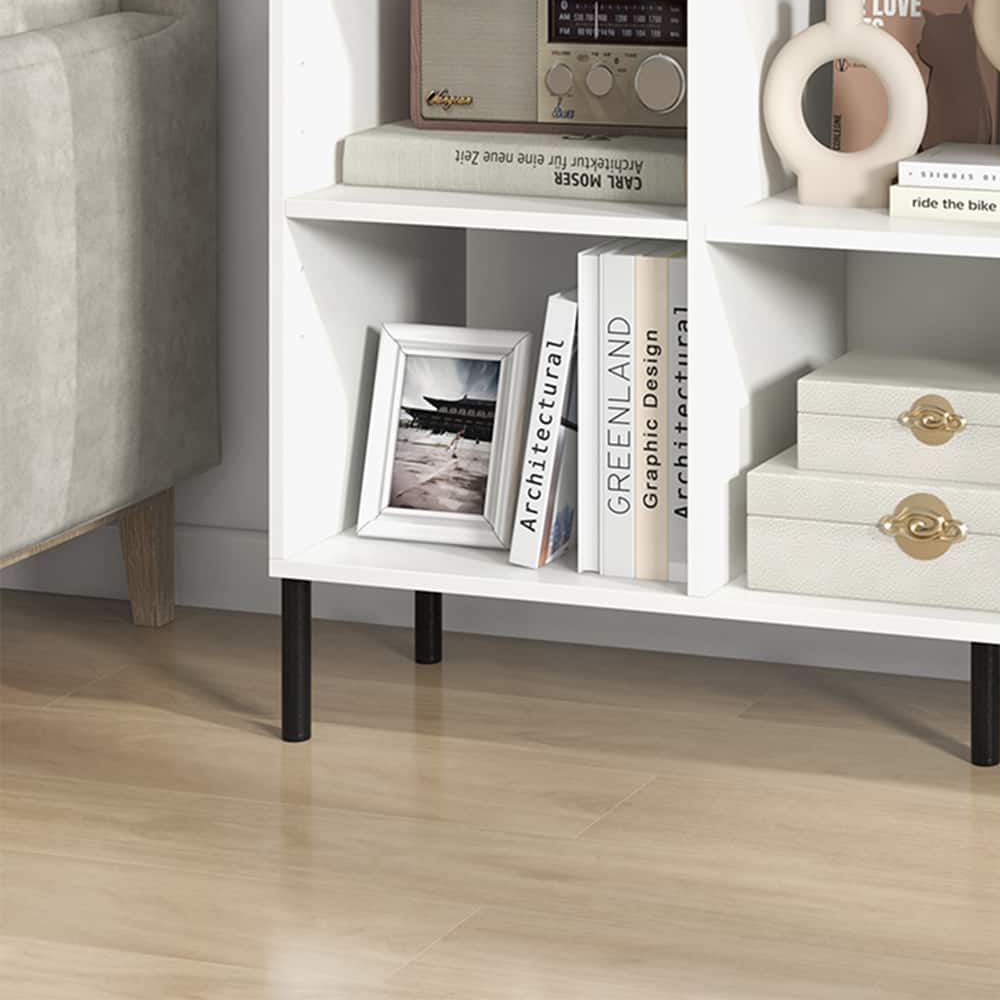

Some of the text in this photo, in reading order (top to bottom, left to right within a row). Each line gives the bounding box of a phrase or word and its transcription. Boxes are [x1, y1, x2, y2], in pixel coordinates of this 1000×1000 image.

[455, 149, 644, 174] Architektur für eine neue Zeit
[553, 171, 643, 190] CARL MOSER
[911, 196, 998, 212] ride the bike
[518, 337, 566, 533] Architectural
[606, 315, 632, 516] GREENLAND
[642, 328, 663, 510] Graphic Design
[672, 306, 688, 520] Architectural
